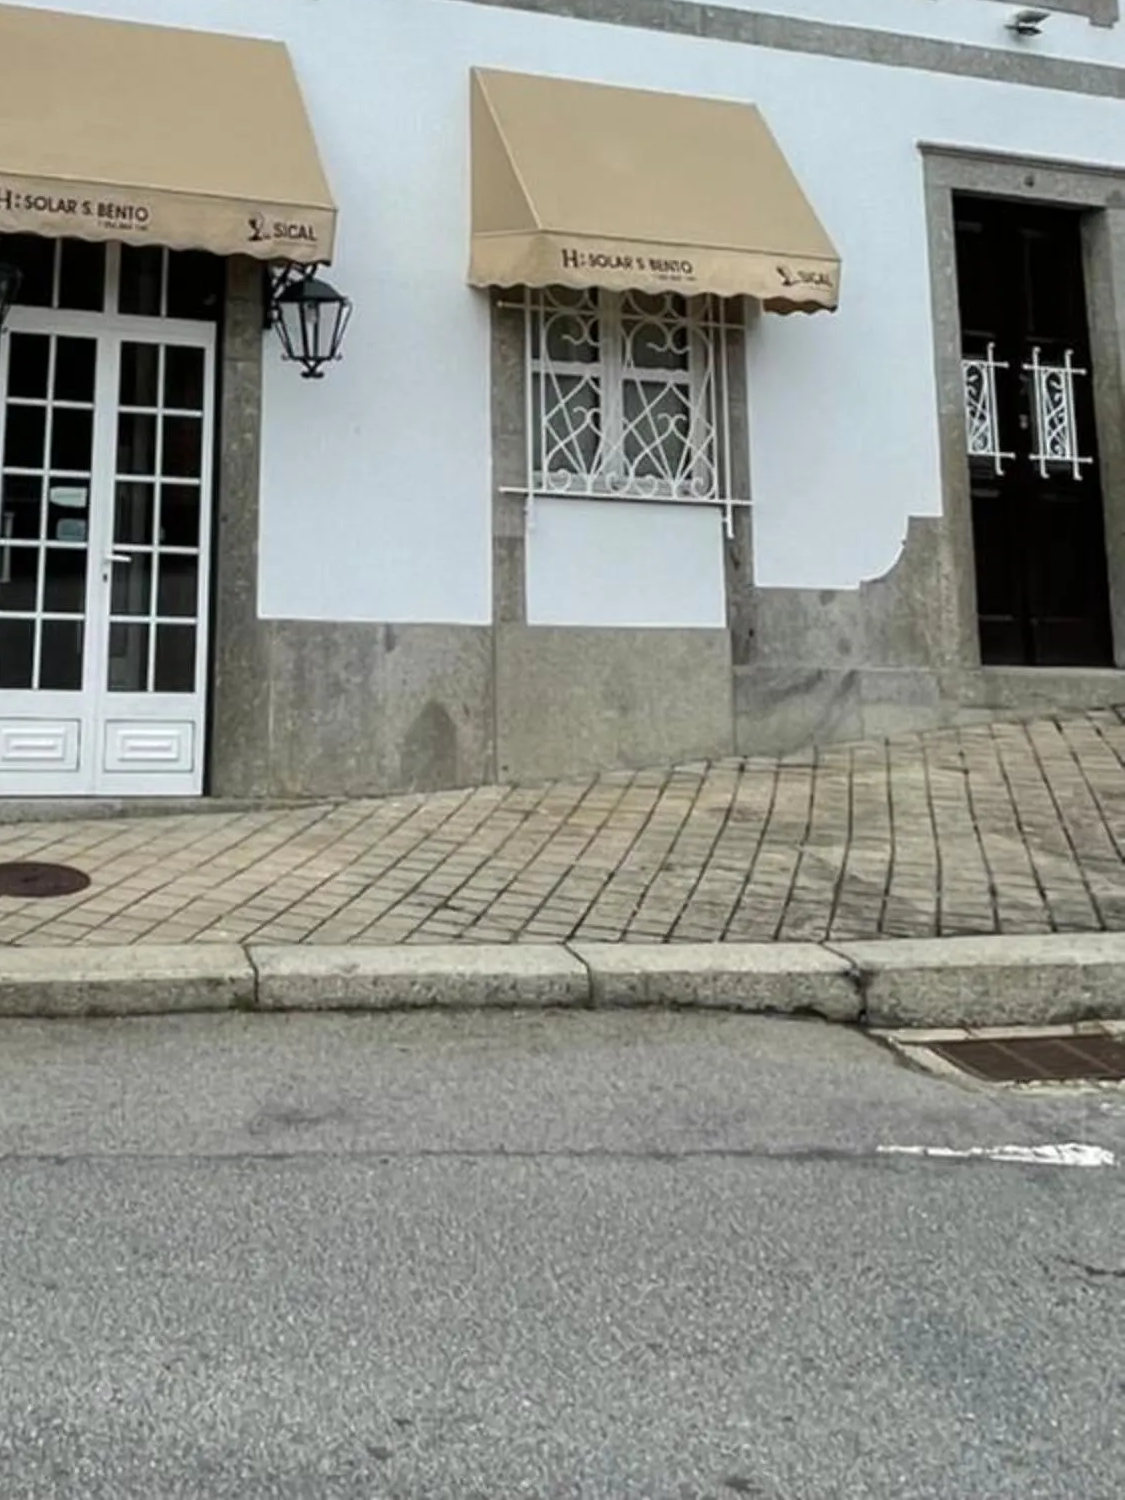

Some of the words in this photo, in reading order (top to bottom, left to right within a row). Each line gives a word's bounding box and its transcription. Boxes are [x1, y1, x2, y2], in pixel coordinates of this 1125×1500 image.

[24, 195, 77, 214] SOLAR
[96, 203, 150, 222] BENTO
[273, 222, 318, 242] SICAL
[588, 253, 633, 270] SOLAR
[649, 258, 693, 274] BENTO
